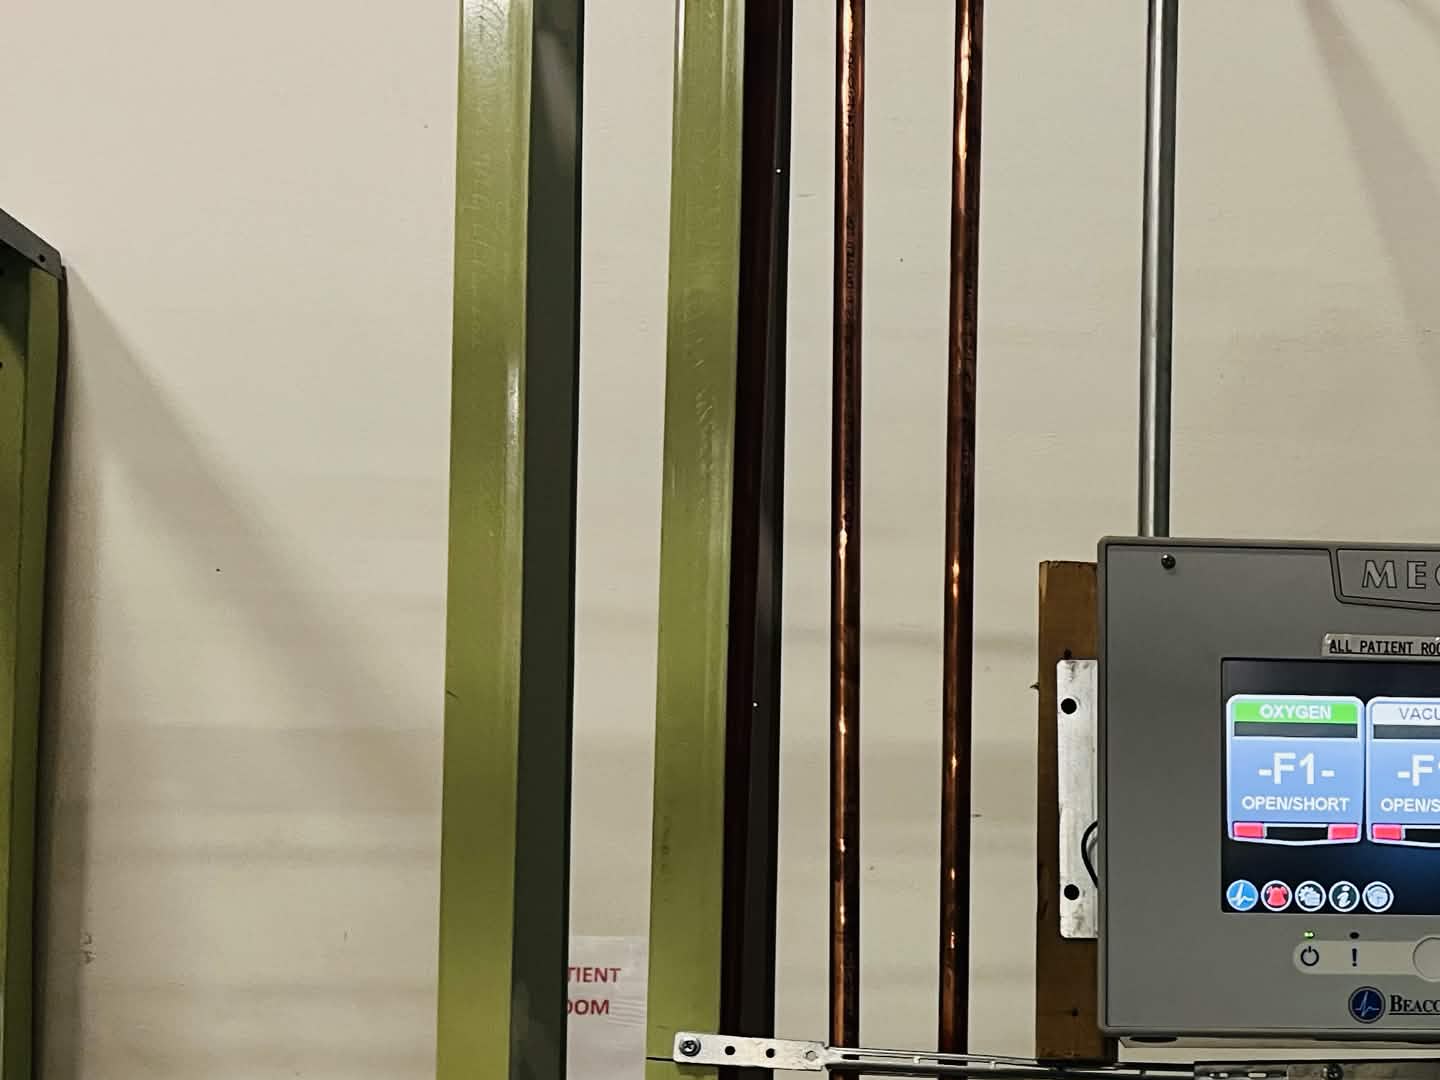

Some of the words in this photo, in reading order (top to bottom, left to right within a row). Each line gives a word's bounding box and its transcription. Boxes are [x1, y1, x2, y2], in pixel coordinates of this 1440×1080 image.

[1330, 639, 1350, 652] ALL
[1359, 640, 1414, 655] PATIENT
[1259, 704, 1332, 720] OXYGEN
[1258, 752, 1335, 785] -F1-
[1241, 796, 1350, 811] OPEN/SHORT
